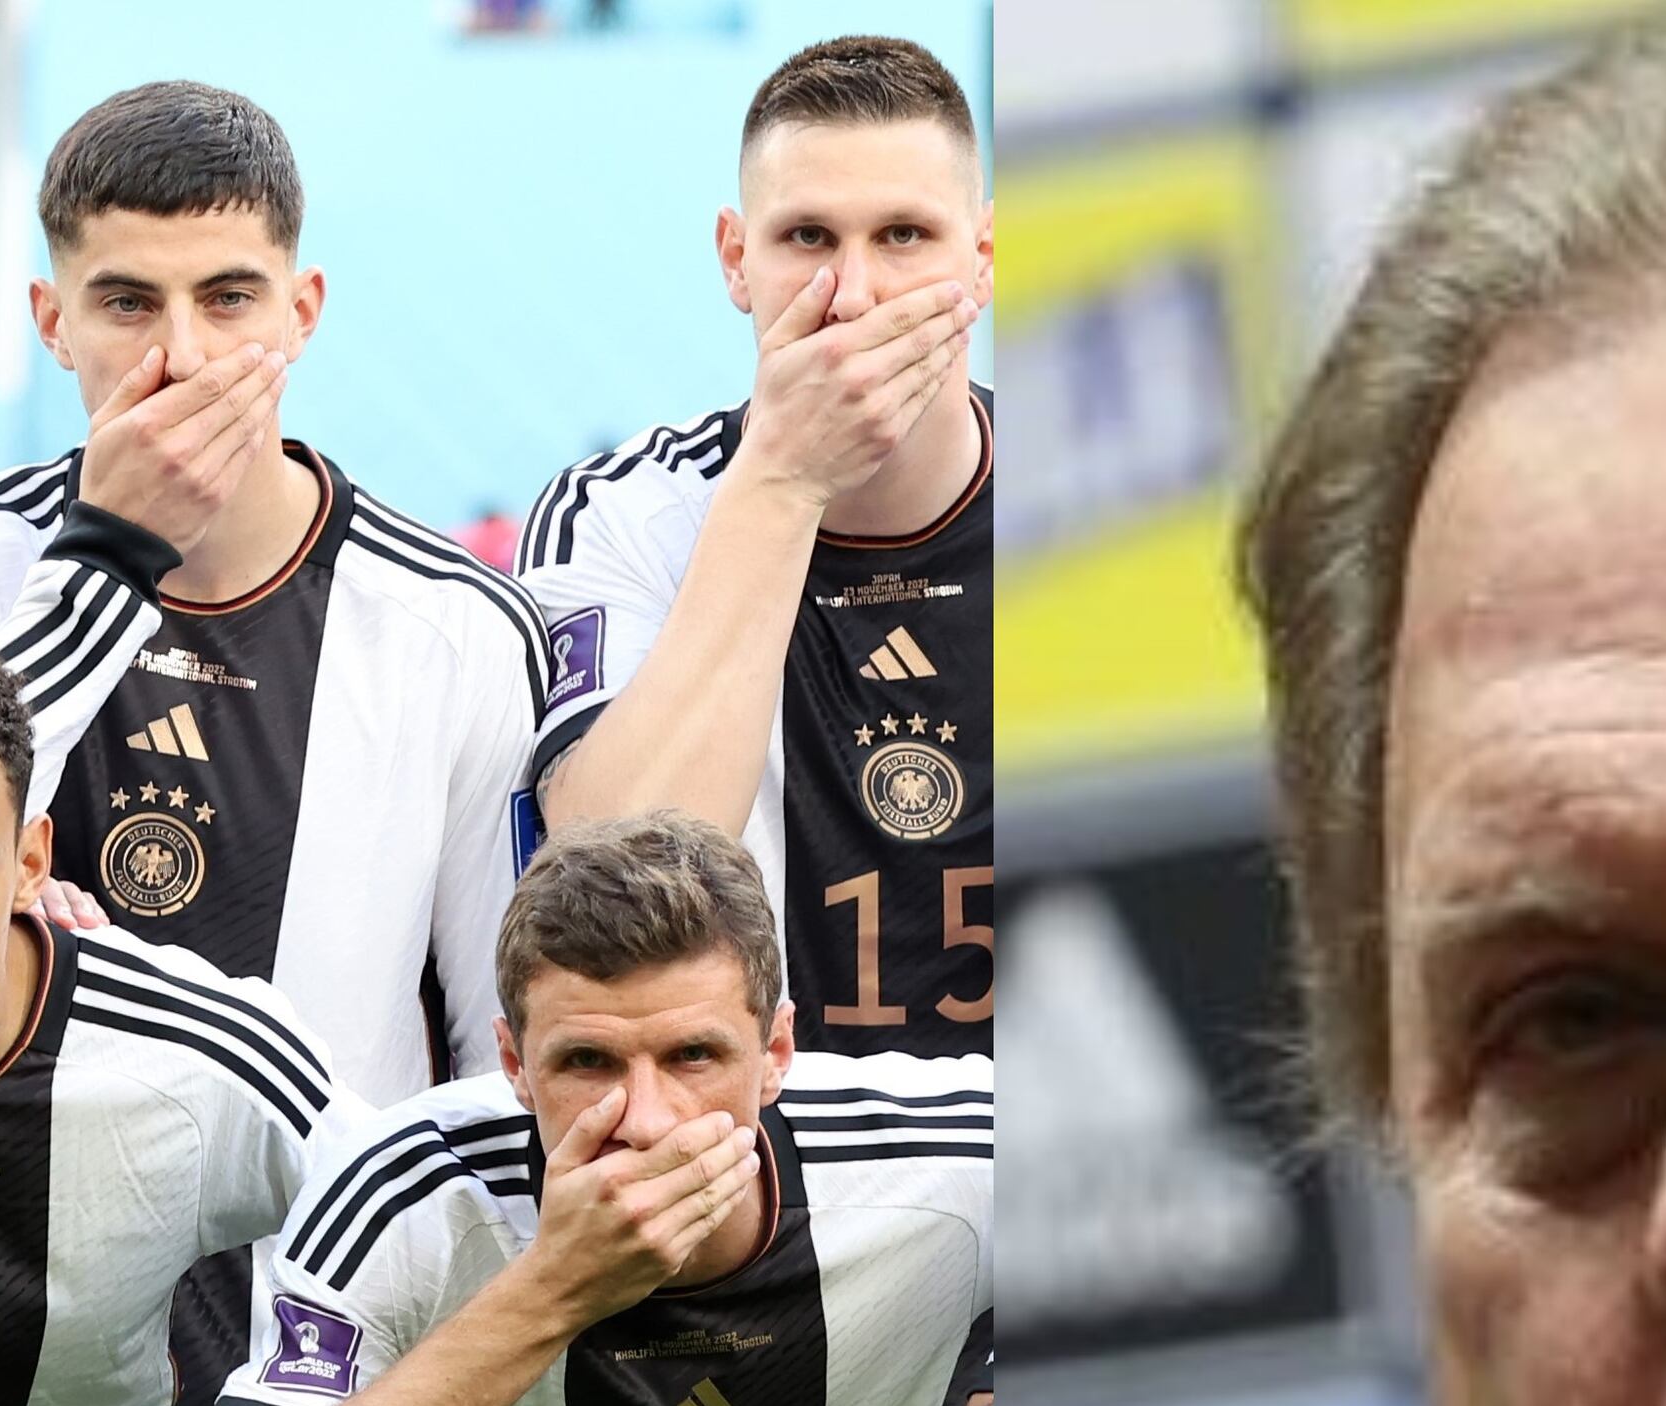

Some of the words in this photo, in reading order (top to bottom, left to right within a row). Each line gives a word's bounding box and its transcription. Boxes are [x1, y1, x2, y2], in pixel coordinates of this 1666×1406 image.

[871, 572, 901, 585] JAPAN
[843, 586, 854, 597] 23
[857, 582, 905, 596] NOVEMBER
[907, 578, 929, 589] 2022
[852, 591, 921, 607] INTERNATIONAL
[202, 663, 225, 675] 2022
[217, 675, 257, 690] STADIUM
[880, 755, 938, 775] DEUTSCHER
[127, 826, 185, 850] DEUTSCHER
[824, 866, 994, 1026] 15
[714, 1331, 738, 1344] 2022
[615, 1349, 656, 1361] KHALIFA
[732, 1333, 772, 1351] STADIUM
